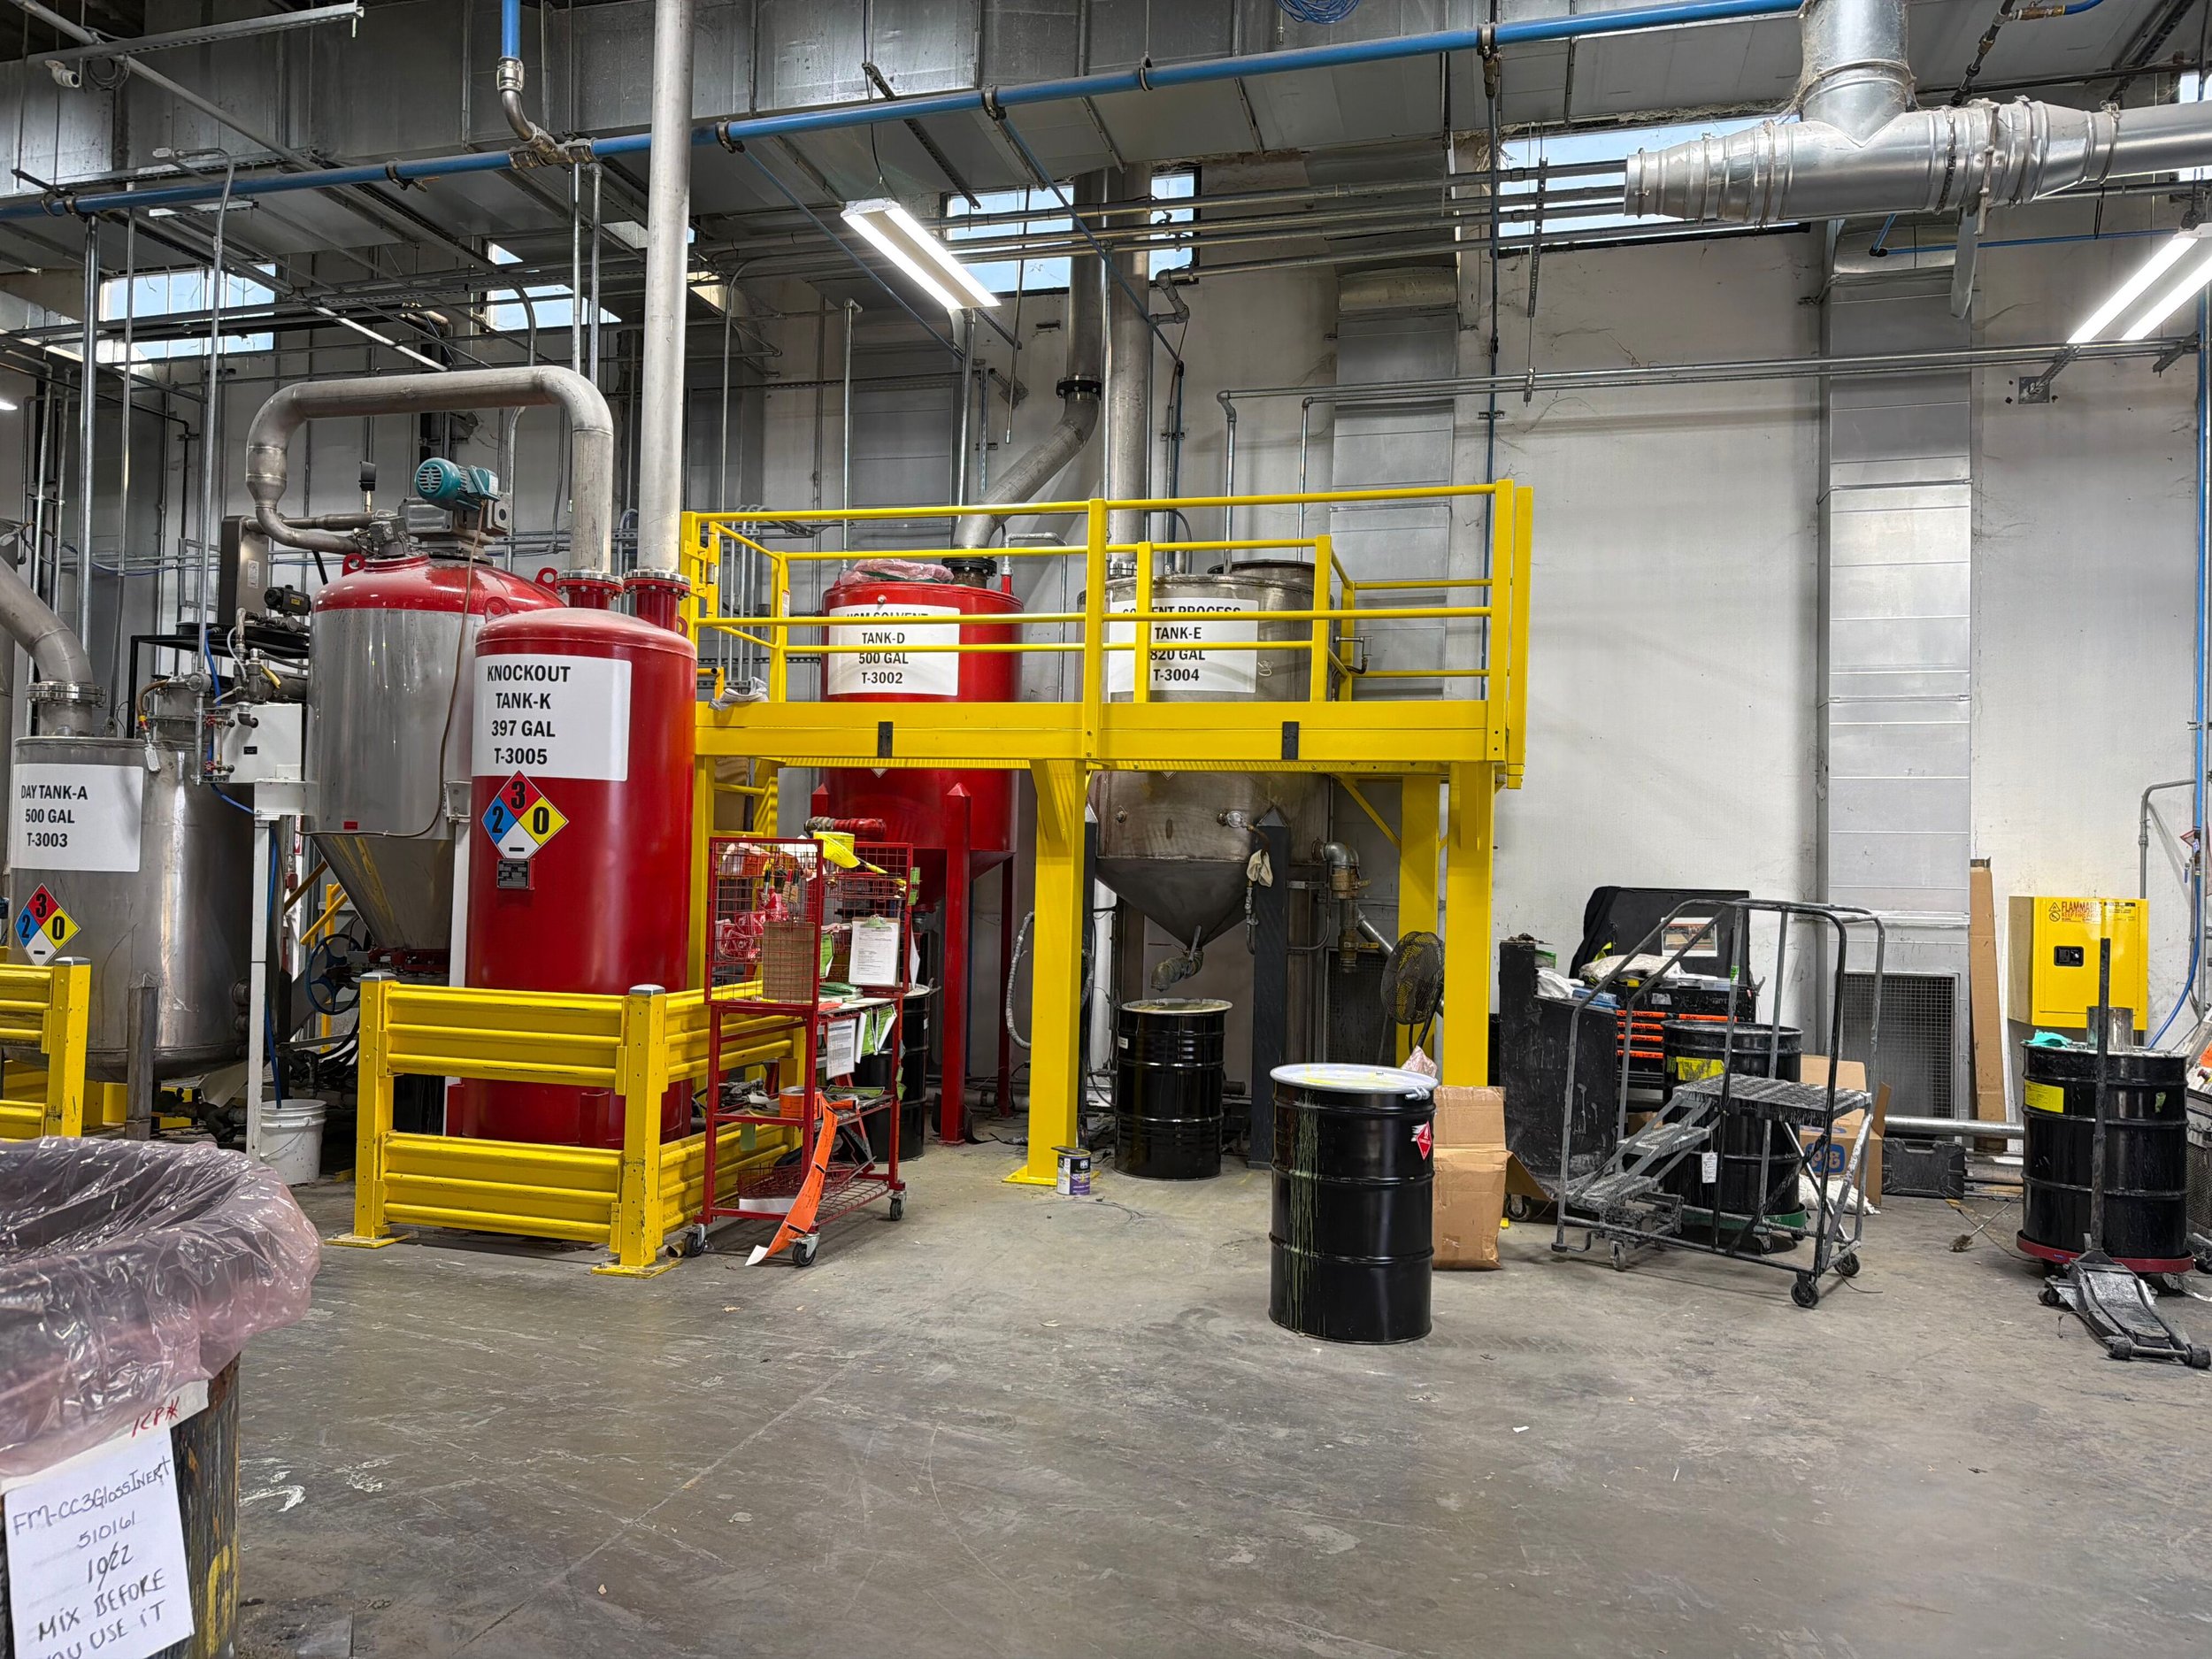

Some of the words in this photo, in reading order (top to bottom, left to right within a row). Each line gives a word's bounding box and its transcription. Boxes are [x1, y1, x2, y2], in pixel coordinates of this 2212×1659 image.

[862, 632, 906, 644] TANK-D
[1154, 626, 1202, 640] TANK-E
[858, 652, 880, 664] 500
[884, 652, 909, 664] GAL
[1150, 650, 1175, 661] 820
[1179, 650, 1206, 661] GAL
[487, 664, 572, 683] KNOCKOUT
[861, 672, 903, 684] T-3002
[1153, 668, 1200, 681] T-3004
[495, 692, 551, 710] TANK-K
[491, 719, 518, 737] 397
[521, 720, 556, 738] GAL
[494, 747, 548, 765] T-3005
[20, 784, 39, 800] DAY
[39, 784, 88, 801] TANK-A
[511, 780, 526, 809] 3
[25, 808, 45, 824] 500
[47, 809, 75, 825] GAL
[492, 806, 503, 833] 2
[533, 806, 549, 835] 0
[27, 832, 68, 848] T-3003
[35, 893, 48, 918] 3
[21, 912, 30, 939] 2
[51, 915, 65, 941] 0
[77, 1509, 134, 1548] 510161
[94, 1568, 166, 1618] BEFORE
[89, 1617, 129, 1649] USE
